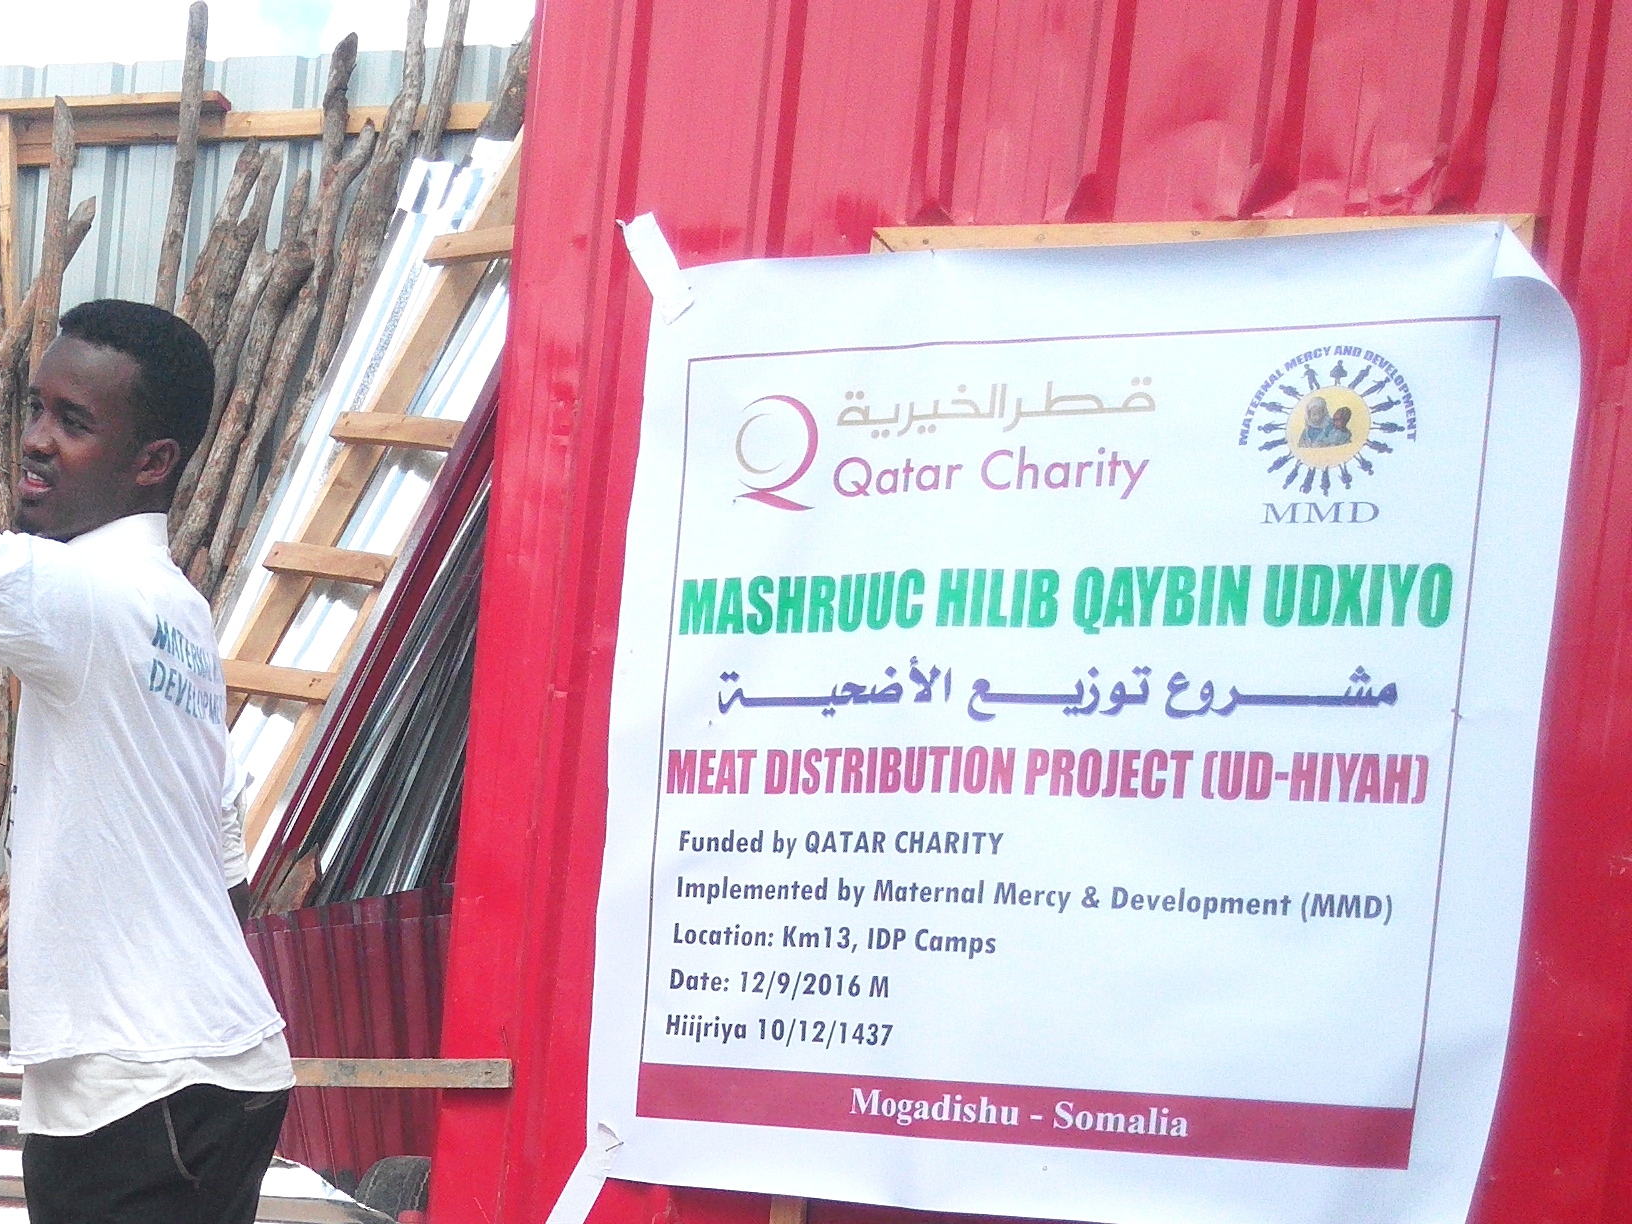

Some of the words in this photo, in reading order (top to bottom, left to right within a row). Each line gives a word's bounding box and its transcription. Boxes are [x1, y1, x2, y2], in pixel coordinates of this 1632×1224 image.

[836, 383, 1008, 439] الخيرية
[1003, 376, 1156, 433] قطر
[1238, 369, 1284, 446] MATERNAL
[1284, 346, 1332, 371] MERCY
[1333, 345, 1362, 356] AND
[1363, 350, 1417, 442] DEVELOPMENT
[833, 456, 963, 497] Qatar
[980, 446, 1149, 500] Charity
[1260, 501, 1379, 524] MMD
[679, 568, 925, 635] MASHRUUC
[936, 568, 1060, 628] HILIB
[1073, 565, 1251, 634] QAYBIN
[1263, 563, 1453, 628] UDXIYO
[666, 749, 758, 795] MEAT
[764, 746, 1017, 795] DISTRIBUTION
[1024, 748, 1194, 799] PROJECT
[679, 829, 764, 853] Funded
[773, 830, 797, 859] by
[805, 830, 886, 854] QATAR
[895, 831, 1004, 855] CHARITY
[677, 876, 828, 904] Implemented
[838, 877, 865, 907] by
[873, 879, 984, 904] Maternal
[994, 881, 1071, 914] Mercy
[1081, 885, 1100, 909] &
[1111, 886, 1291, 920] Development
[1301, 892, 1393, 926] (MMD)
[673, 923, 773, 948] Location:
[783, 925, 857, 953] Km13,
[867, 928, 906, 950] IDP
[914, 929, 996, 959] Camps
[670, 968, 729, 992] Date:
[741, 971, 861, 1000] 12/9/2016
[869, 975, 889, 998] M
[666, 1014, 747, 1044] Hiijriya
[759, 1018, 893, 1049] 10/12/1437
[849, 1087, 1019, 1126] Mogadishu
[1053, 1100, 1189, 1138] Somalia
